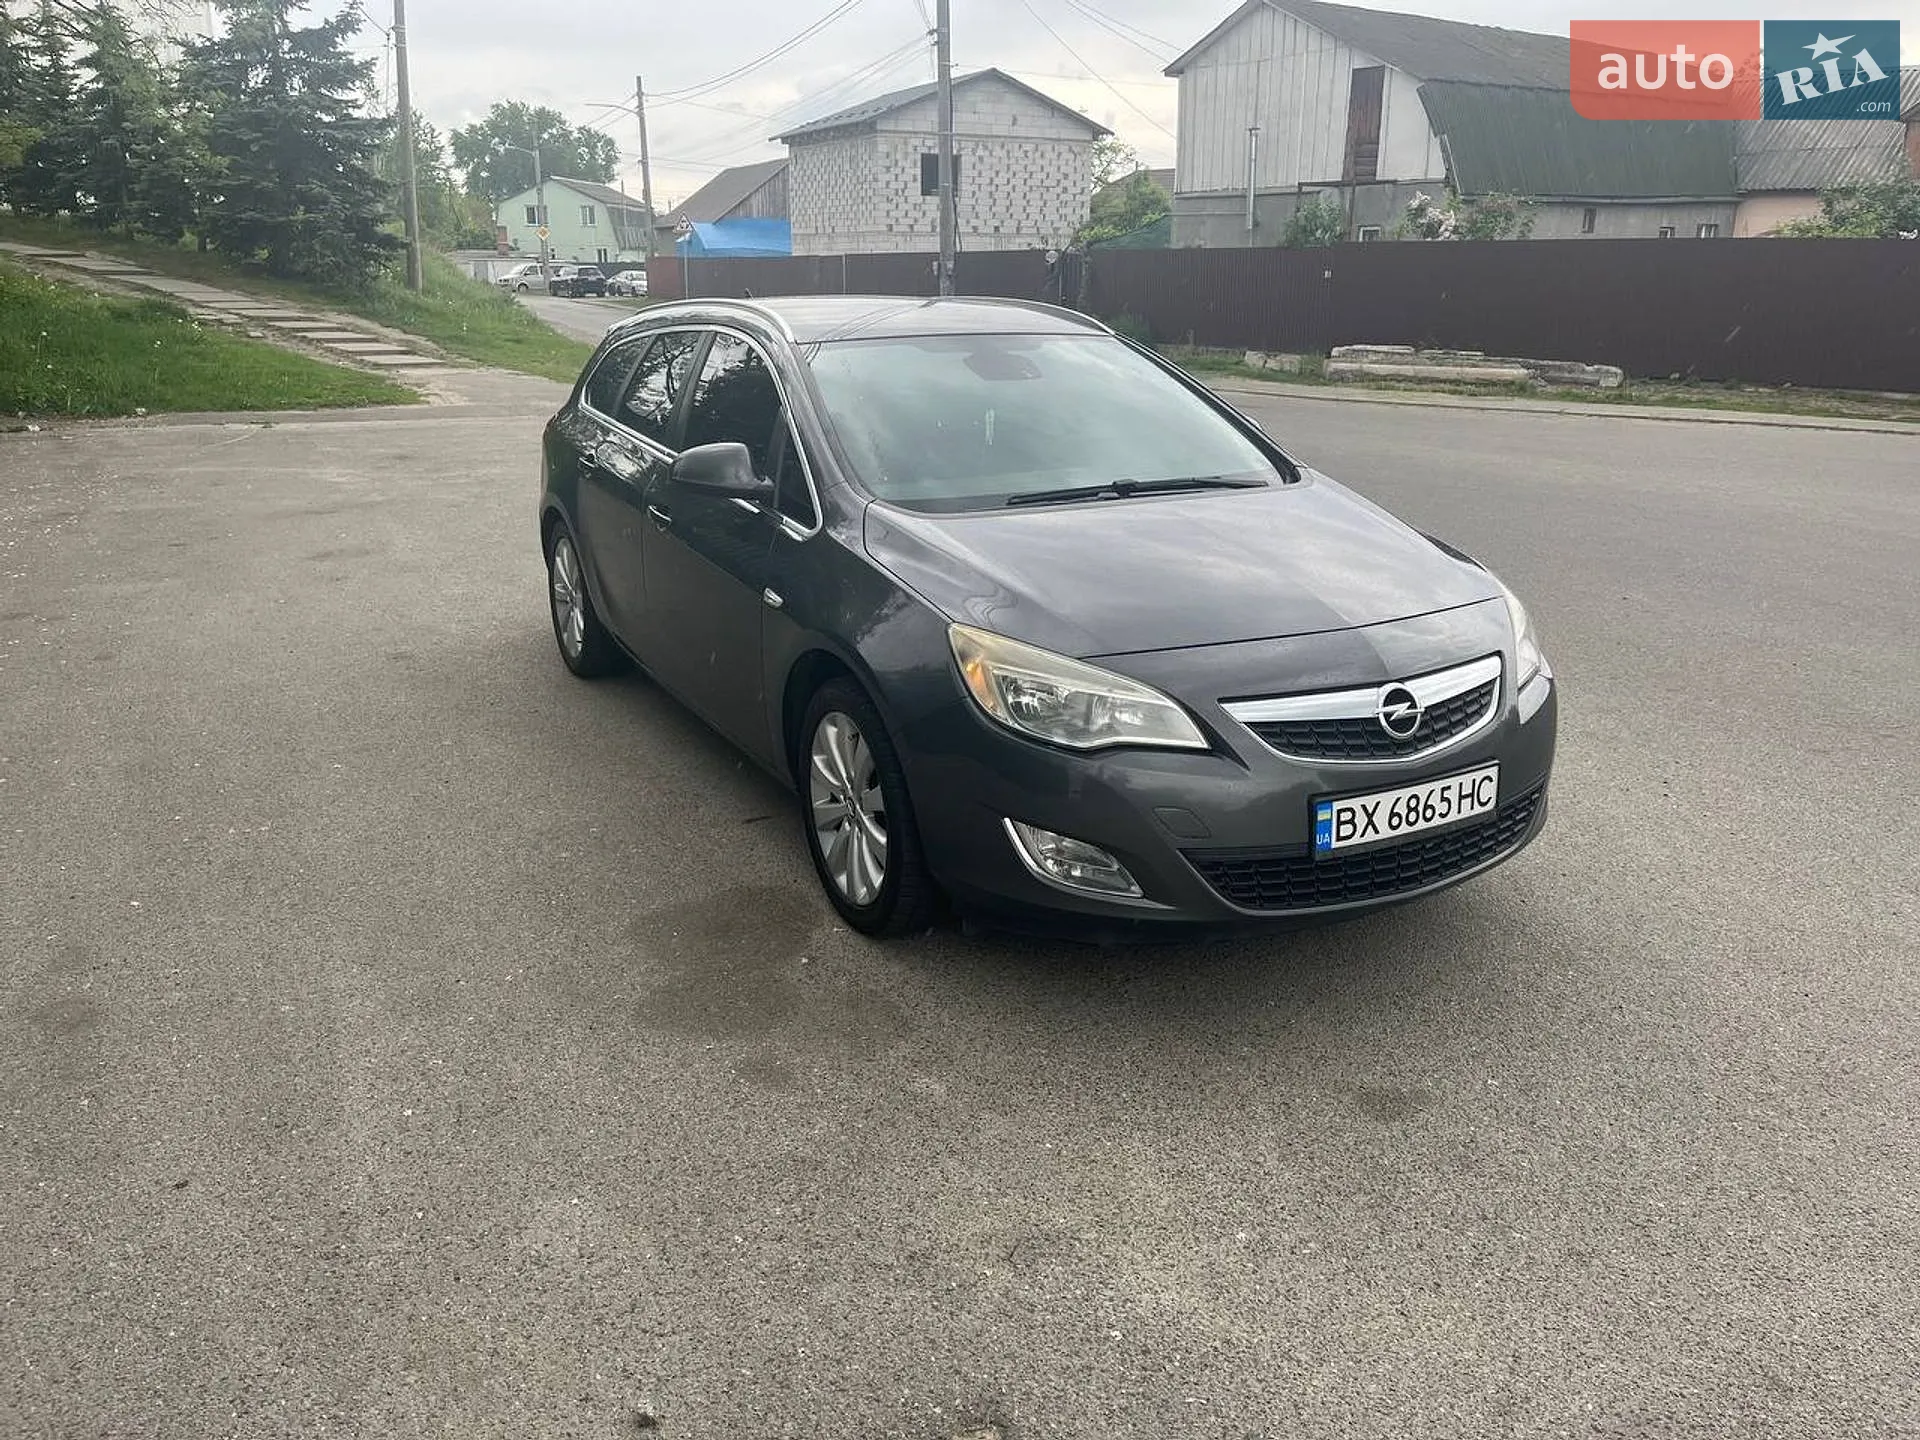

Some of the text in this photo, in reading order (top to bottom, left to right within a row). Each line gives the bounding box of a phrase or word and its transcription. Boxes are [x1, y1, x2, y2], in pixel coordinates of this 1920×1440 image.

[1336, 775, 1494, 842] BX 6865 HC
[1316, 833, 1331, 845] UA
